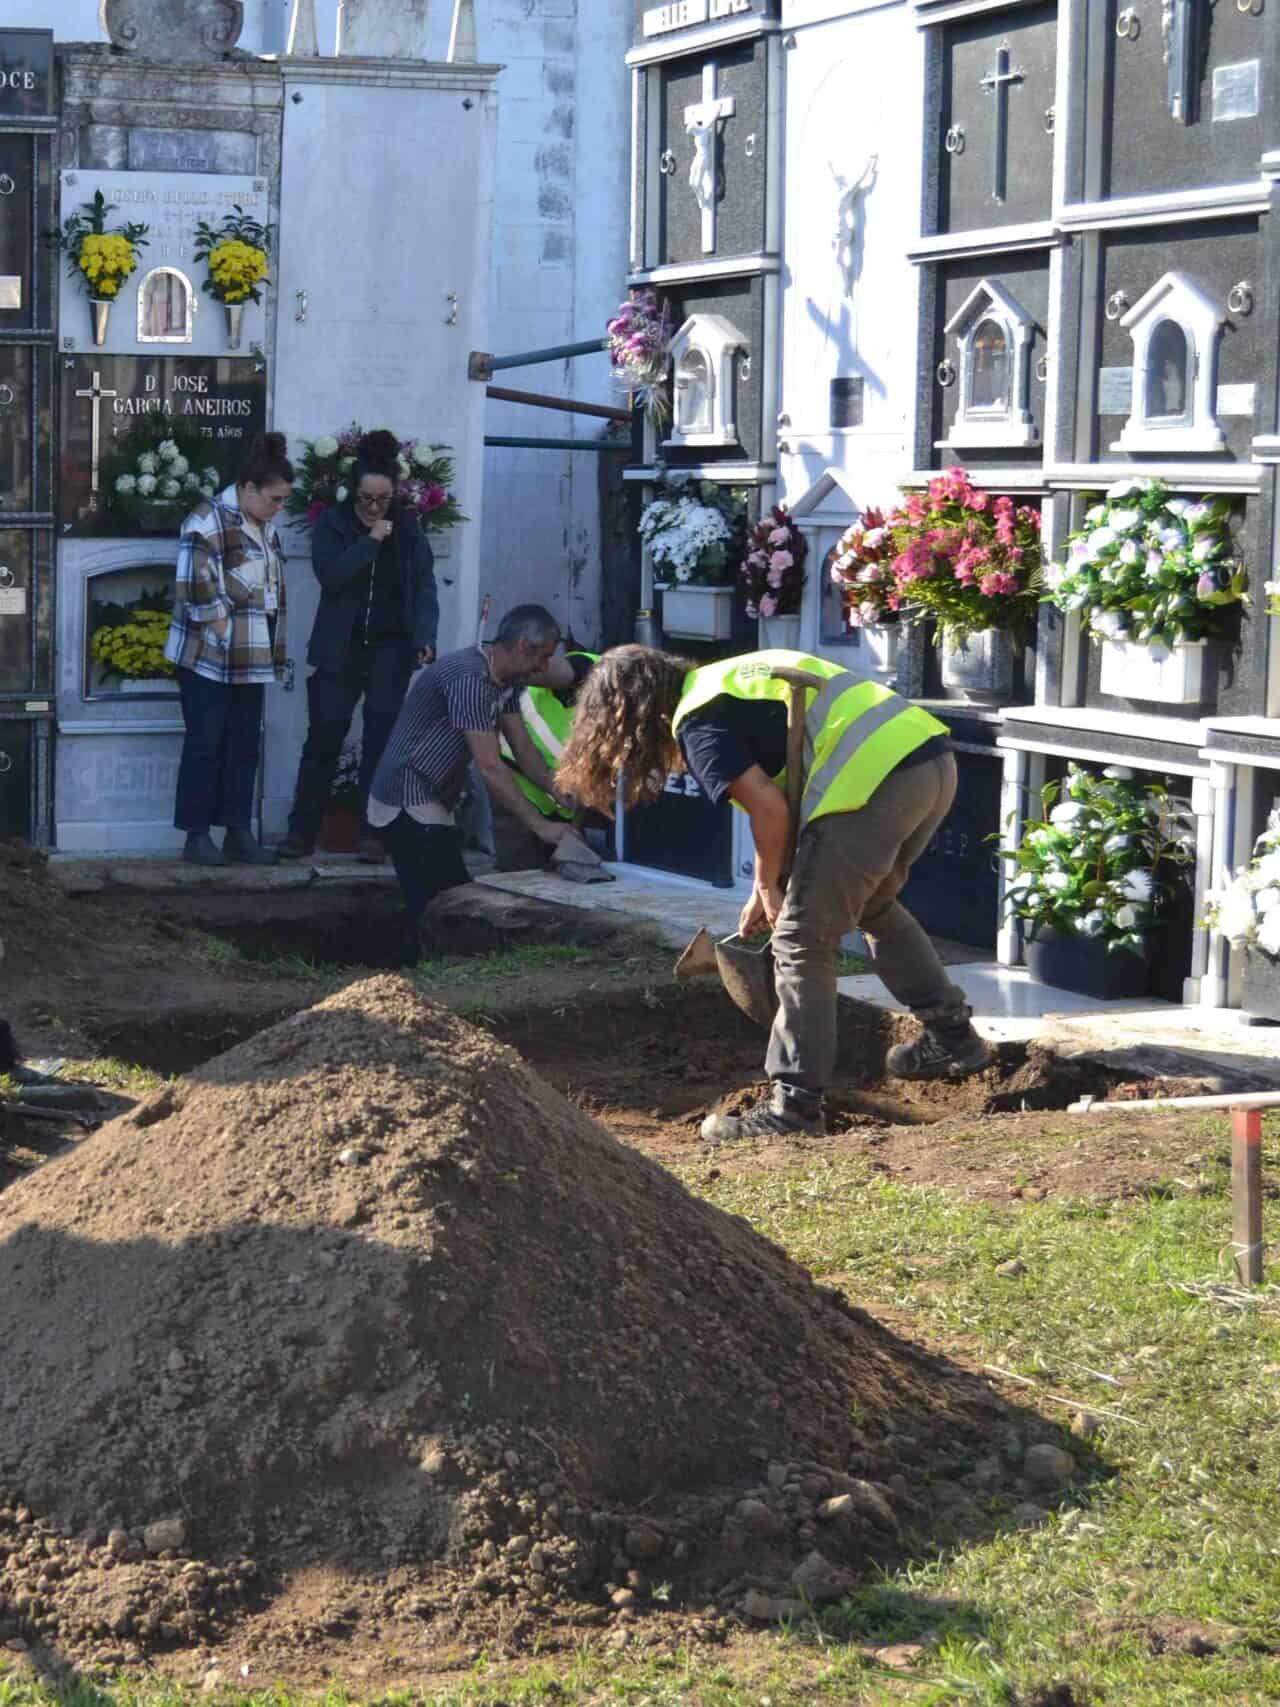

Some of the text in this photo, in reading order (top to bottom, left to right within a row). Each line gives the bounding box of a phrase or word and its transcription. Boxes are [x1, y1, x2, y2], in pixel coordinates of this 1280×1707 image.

[144, 375, 209, 393] D JOSE
[112, 397, 252, 417] GARCIA ANEIROS
